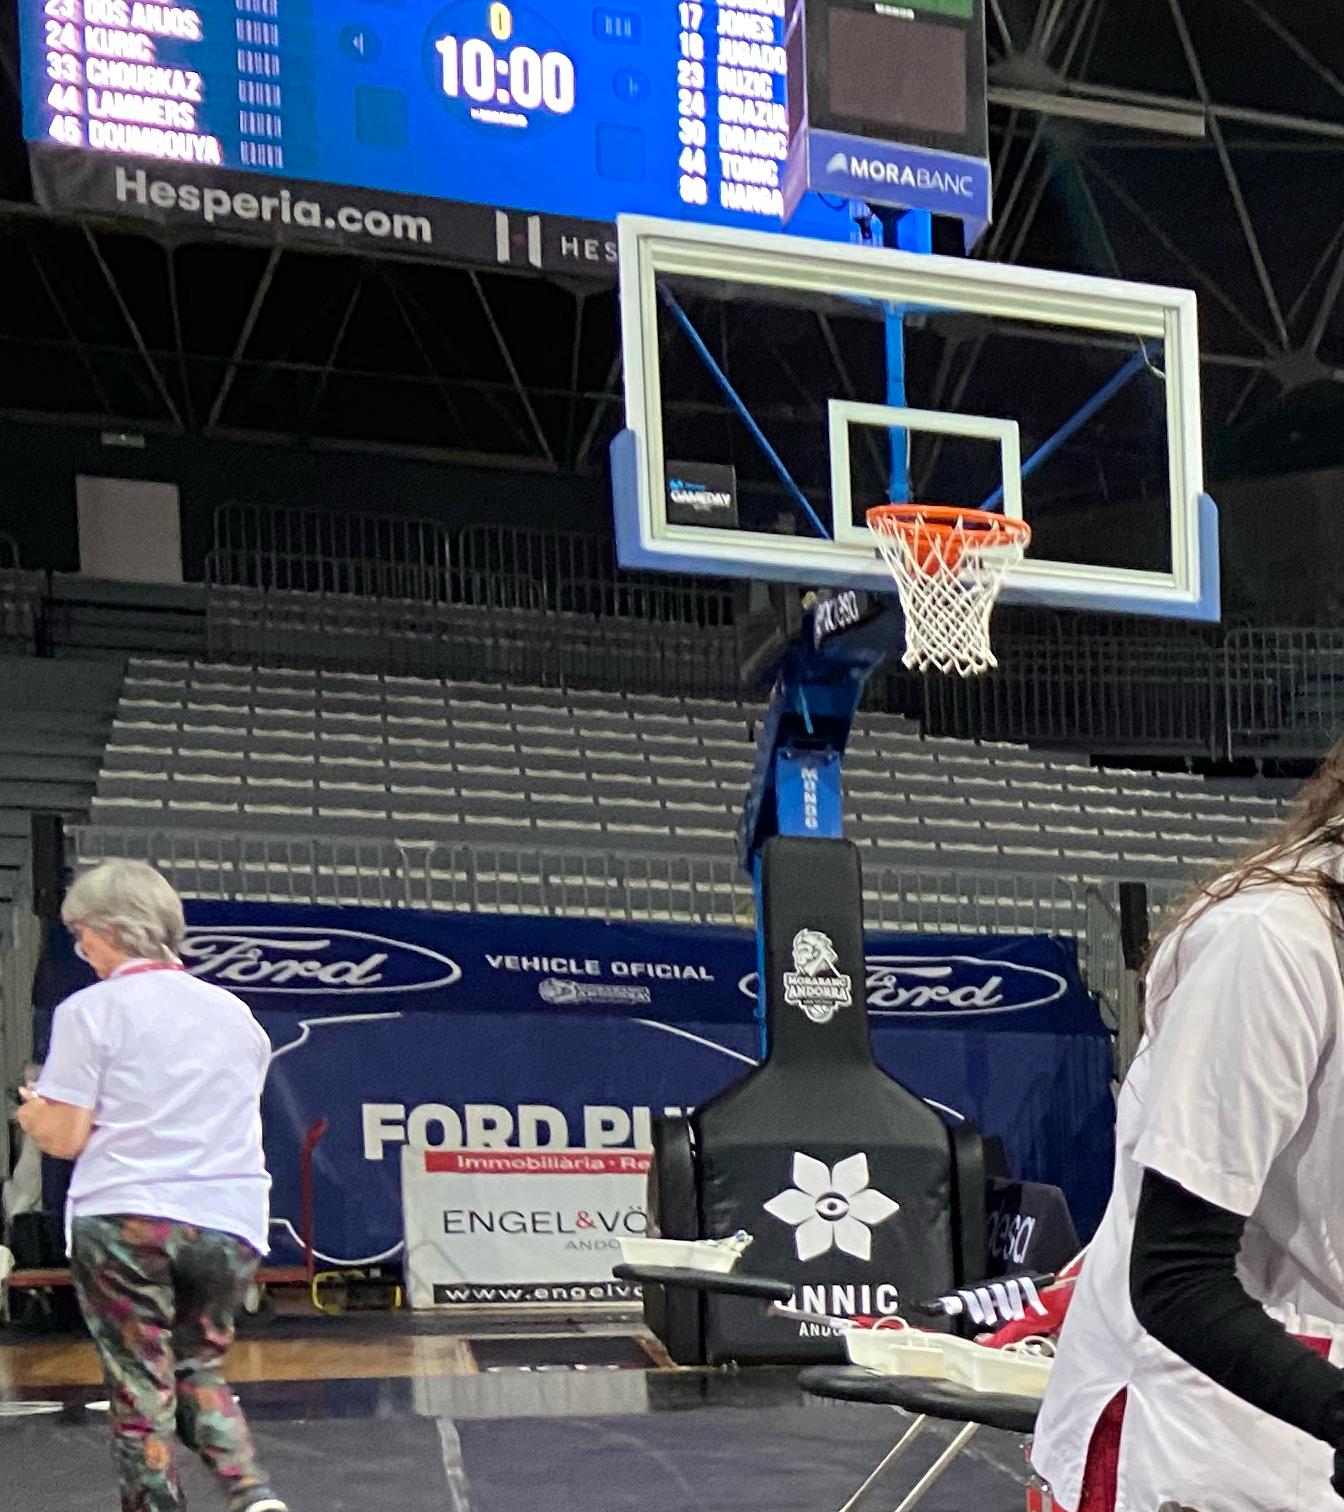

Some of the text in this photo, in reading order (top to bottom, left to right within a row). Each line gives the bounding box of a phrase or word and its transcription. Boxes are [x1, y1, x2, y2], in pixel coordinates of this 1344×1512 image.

[489, 2, 512, 41] 0
[435, 35, 575, 114] 10:00
[850, 156, 974, 198] MORABANC
[114, 166, 433, 244] Hesperia.com
[179, 935, 388, 986] Ford
[484, 954, 715, 981] VEHICLE OFICIAL
[788, 986, 850, 1001] ANDORRA
[362, 1103, 569, 1160] FORD
